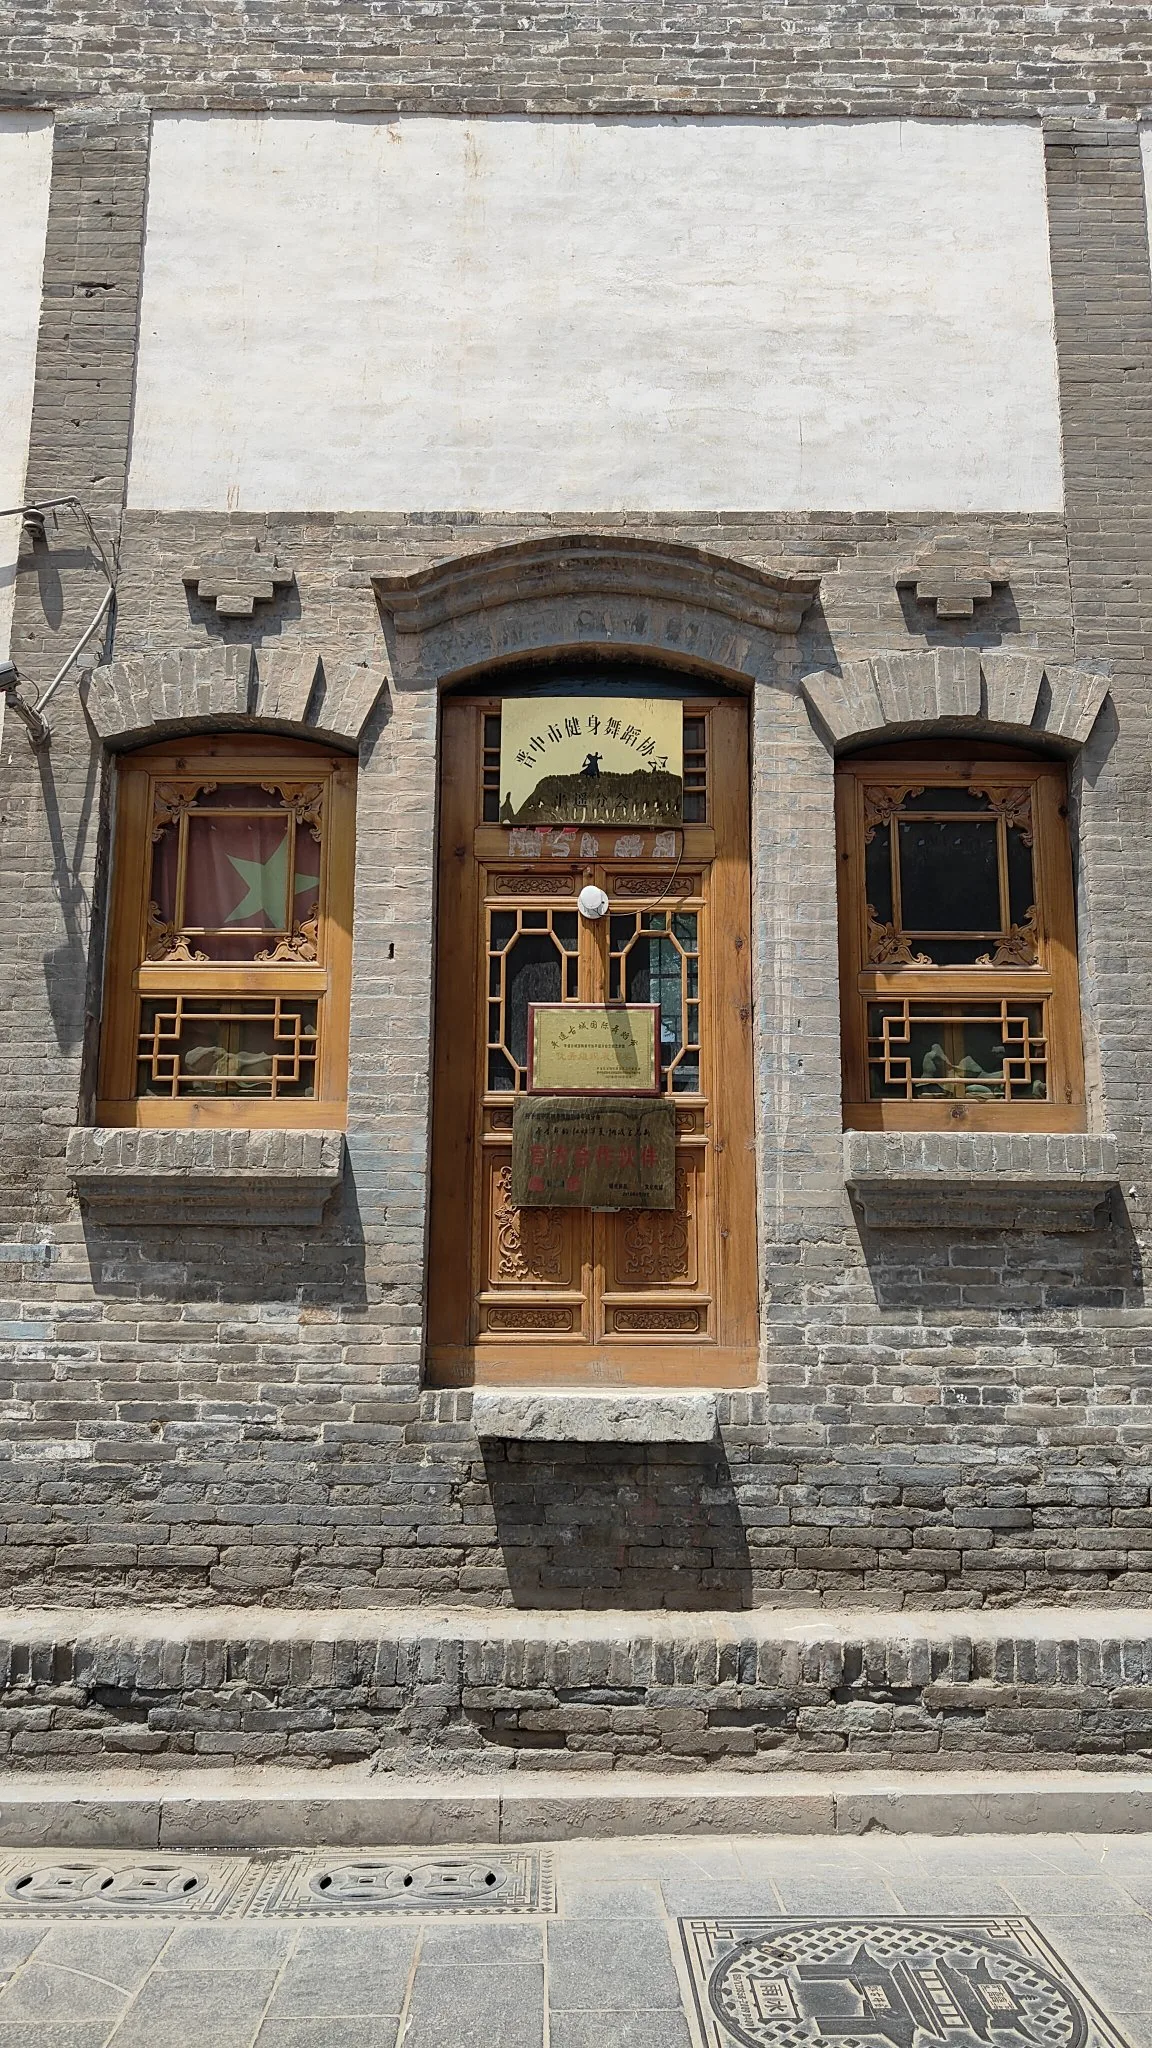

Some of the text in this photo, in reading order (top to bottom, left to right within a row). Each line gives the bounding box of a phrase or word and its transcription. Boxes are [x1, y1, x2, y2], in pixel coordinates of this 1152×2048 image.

[514, 714, 669, 771] 晋中市健身舞蹈协会
[529, 1143, 658, 1168] 官方合作伙伴
[759, 1984, 788, 2013] 雨水
